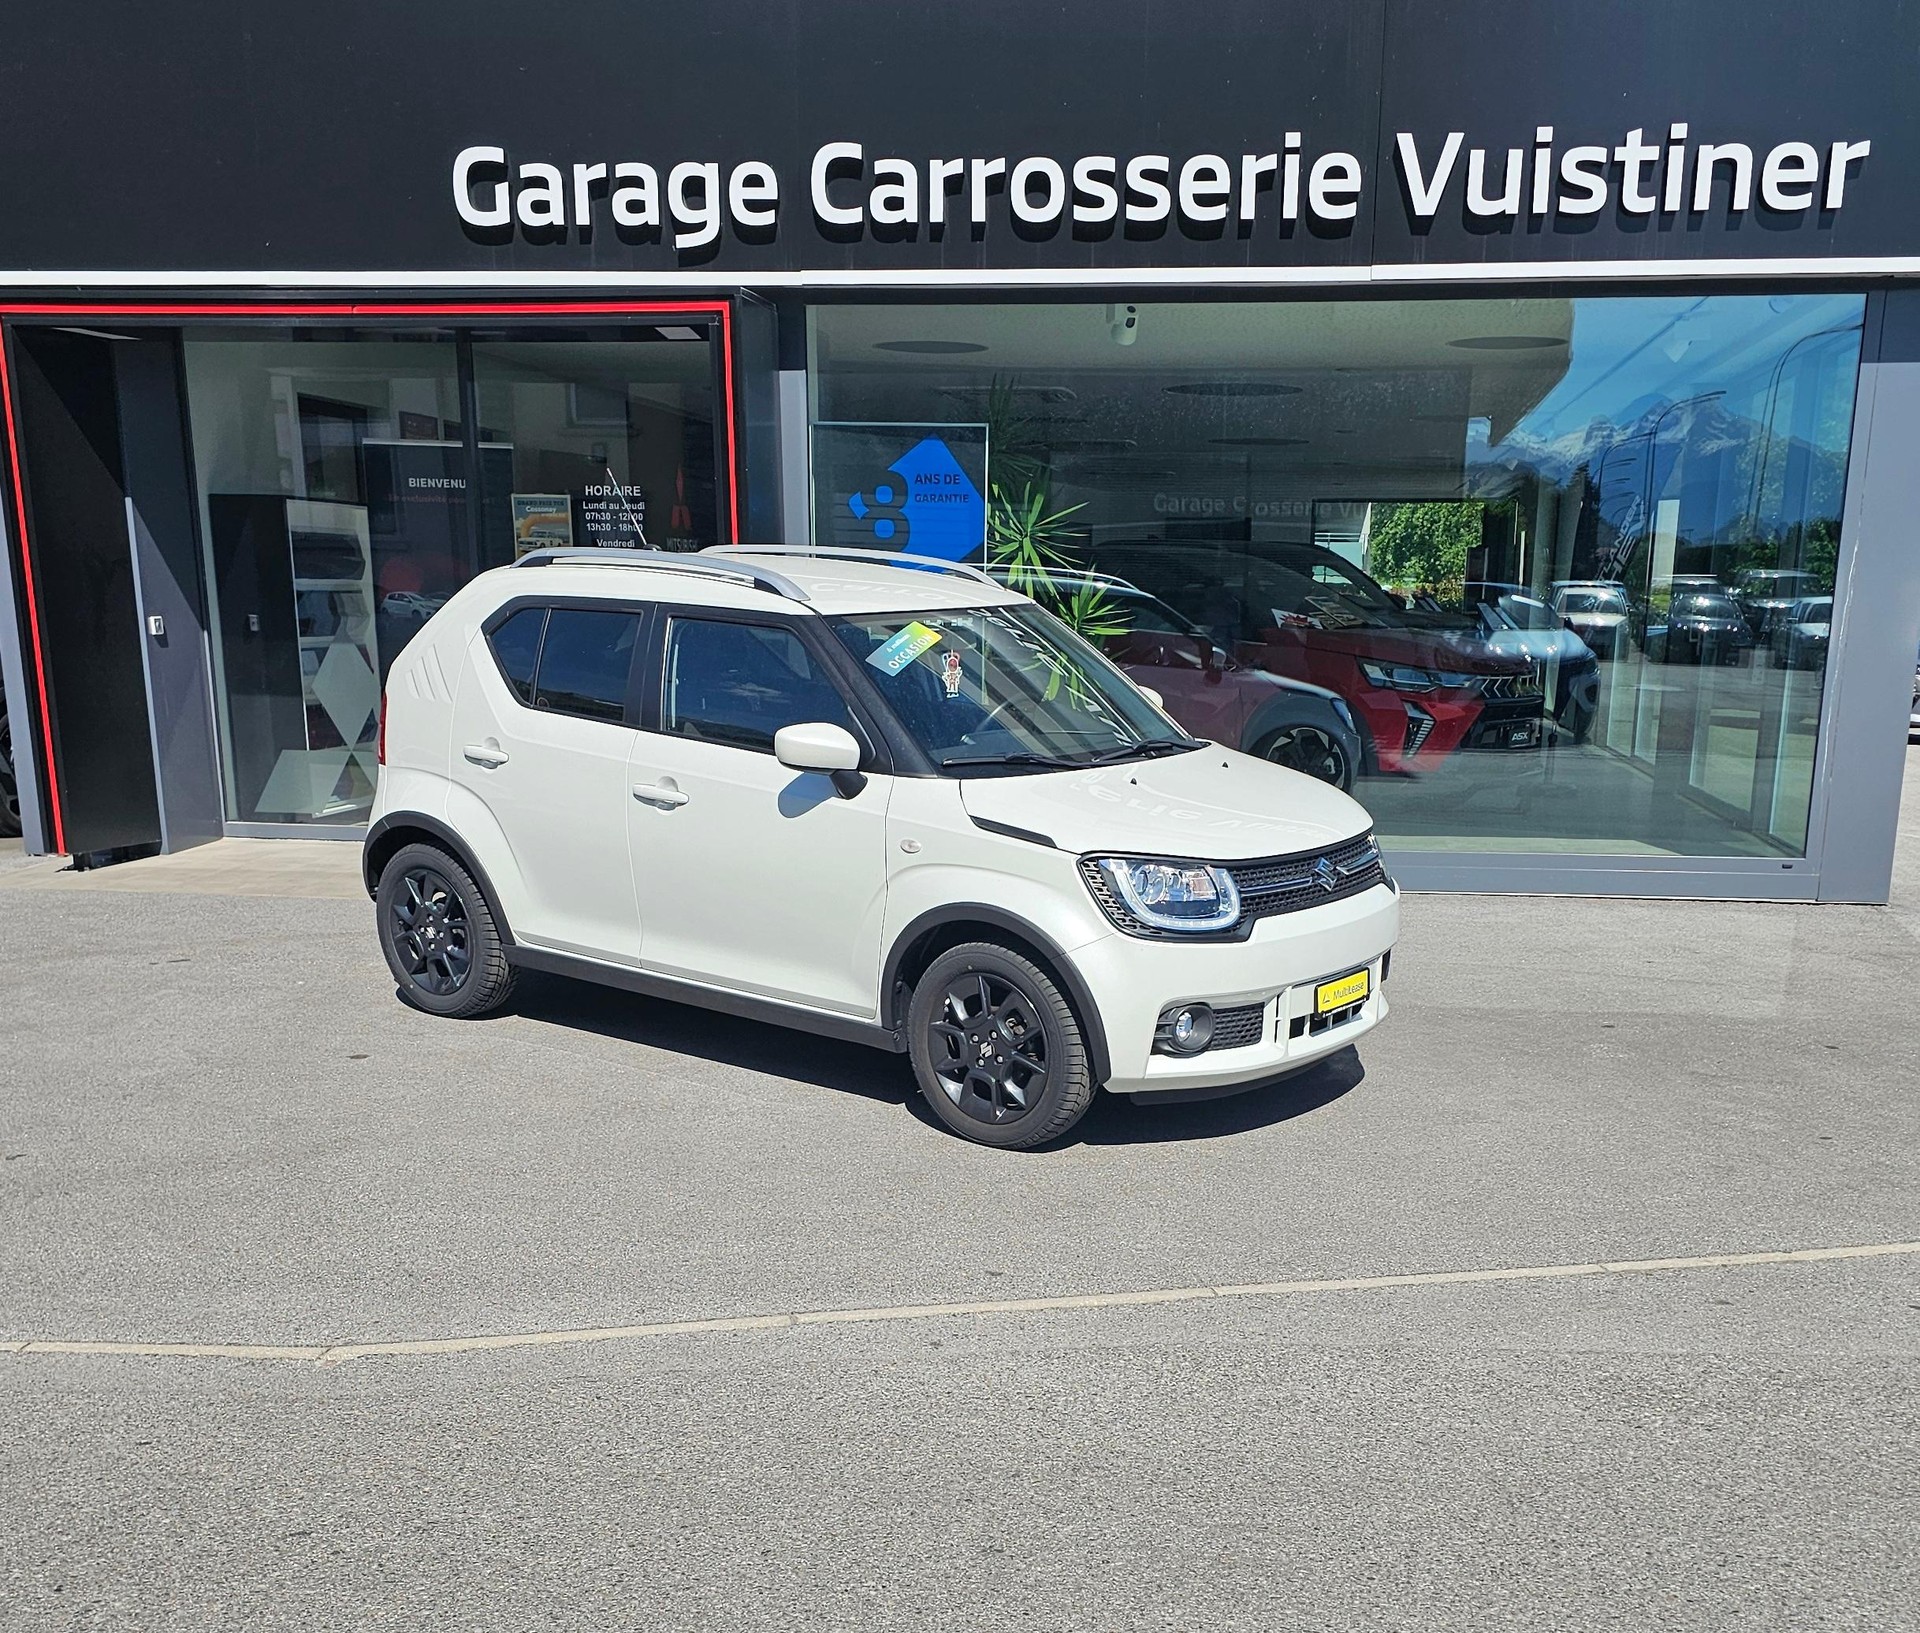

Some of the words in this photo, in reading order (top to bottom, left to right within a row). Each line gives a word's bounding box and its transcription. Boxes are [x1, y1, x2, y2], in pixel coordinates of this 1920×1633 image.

[452, 145, 779, 249] Garage
[811, 131, 1362, 228] Carrosserie
[1396, 122, 1871, 217] Vuistiner
[914, 473, 941, 485] ANS
[944, 473, 961, 485] DE
[584, 485, 642, 497] HORAIRE
[914, 493, 970, 504] GARANTIE
[582, 501, 607, 510] Lundi
[608, 502, 620, 510] au
[621, 502, 646, 510] Jeudi
[585, 512, 611, 521] 07h30
[586, 523, 611, 532] 13h30
[596, 538, 635, 548] Vendredi
[887, 633, 933, 669] OCCASION
[1511, 731, 1529, 741] ASX
